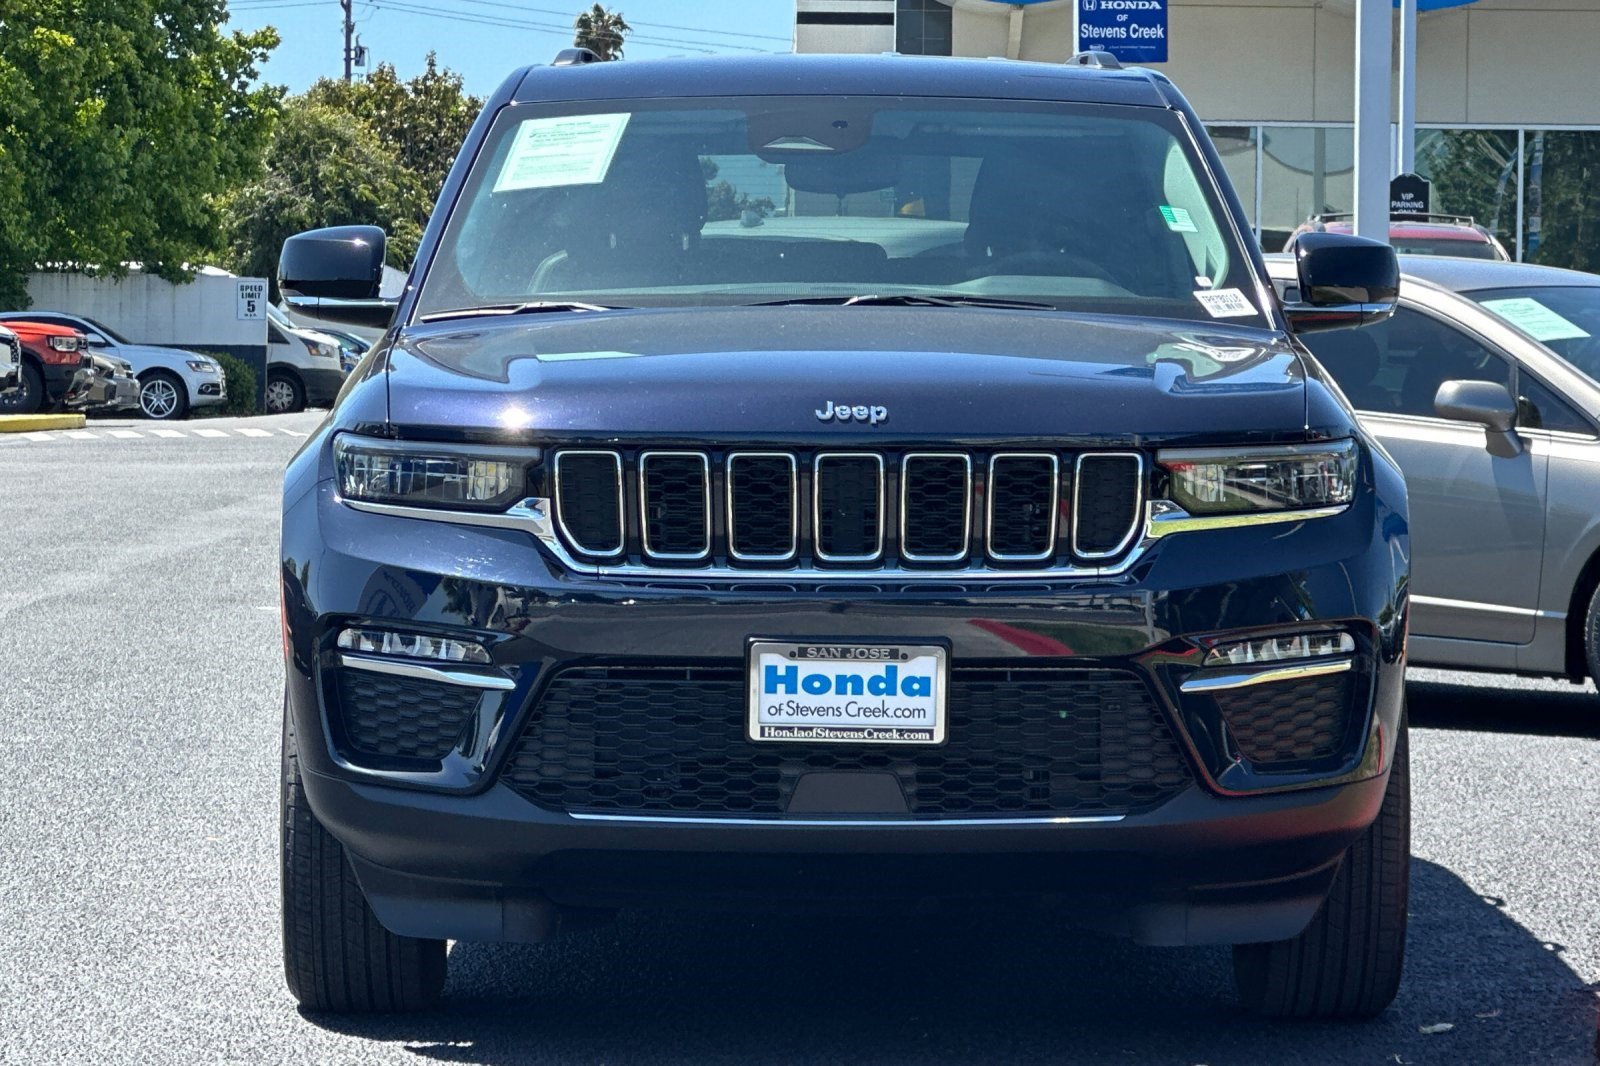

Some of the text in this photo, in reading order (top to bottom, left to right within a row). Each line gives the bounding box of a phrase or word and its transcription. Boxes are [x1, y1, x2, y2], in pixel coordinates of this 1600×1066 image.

[1100, 1, 1162, 10] HONDA
[1116, 14, 1129, 22] OF
[1081, 23, 1165, 39] Stevens Creek
[247, 300, 255, 312] 5
[815, 400, 888, 424] Jeep
[806, 647, 891, 660] SAN JOSE
[764, 664, 931, 698] Honda
[767, 699, 927, 719] of Stevens Creek.com
[764, 726, 931, 741] HondaofStevensCreek.com
